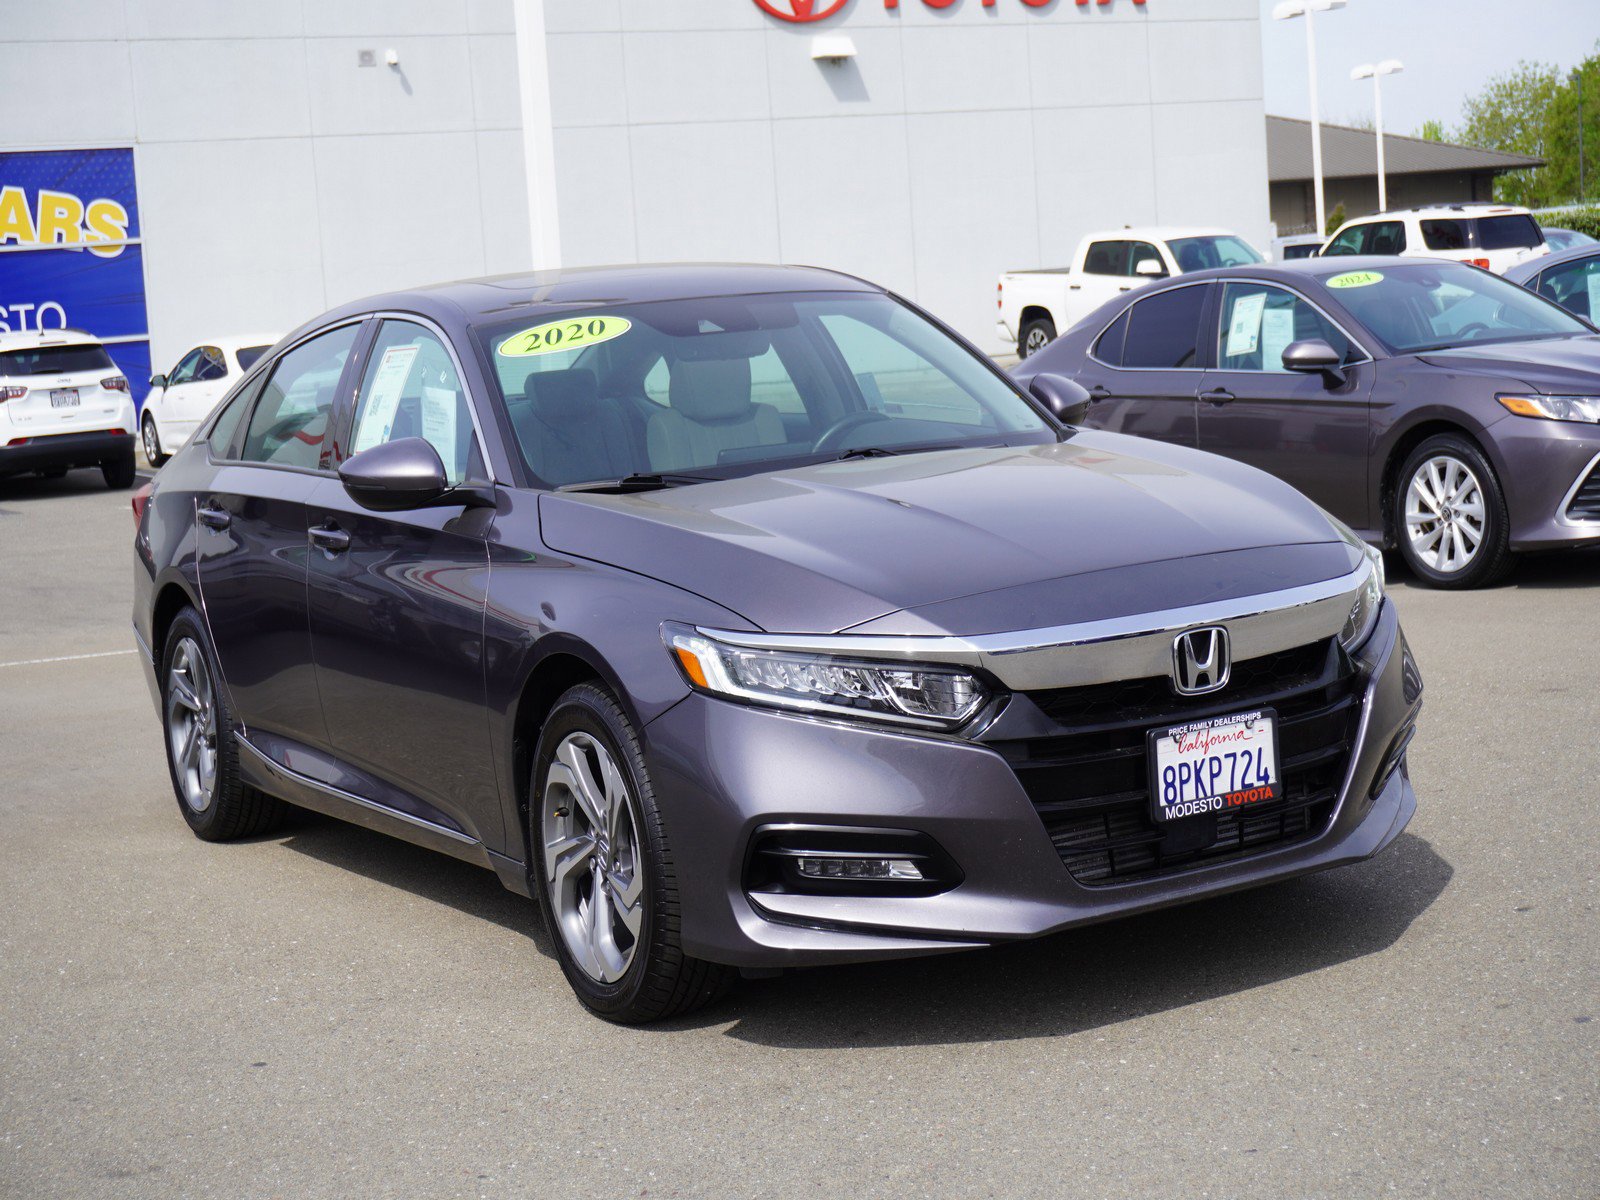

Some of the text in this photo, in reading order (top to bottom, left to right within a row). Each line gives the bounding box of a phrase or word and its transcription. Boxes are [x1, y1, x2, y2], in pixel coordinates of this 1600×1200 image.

[524, 319, 606, 352] 2020
[1168, 711, 1262, 737] PRICE FAMILY DEALERSHIPS
[1177, 727, 1253, 755] California
[1163, 747, 1270, 804] 8PKP724
[1165, 786, 1274, 820] MODESTO TOYOTA
